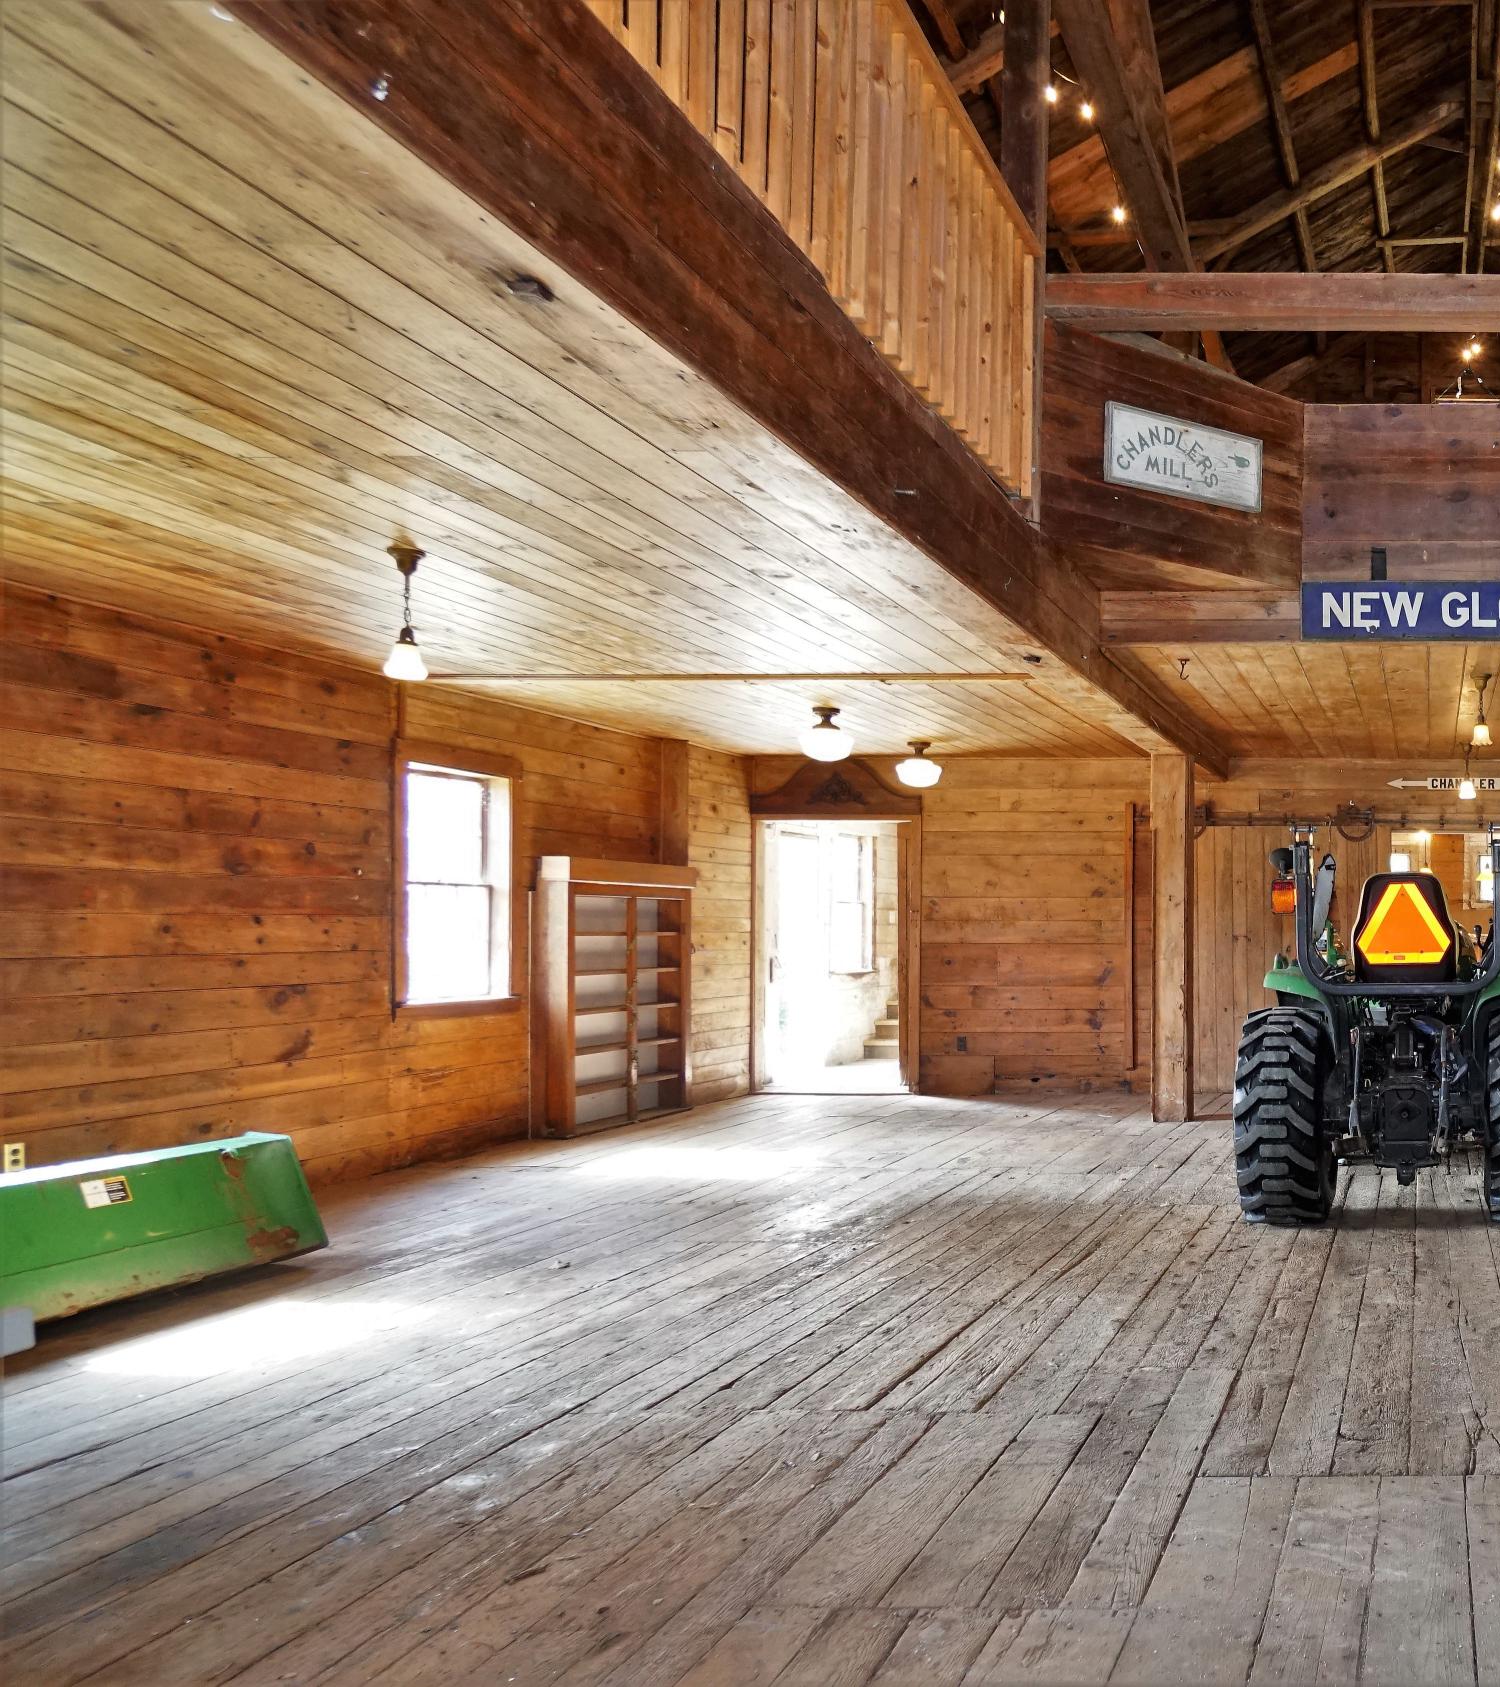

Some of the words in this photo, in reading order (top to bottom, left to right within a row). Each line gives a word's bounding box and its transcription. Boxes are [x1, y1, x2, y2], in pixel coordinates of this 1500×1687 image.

[1145, 454, 1193, 481] MILL
[1321, 591, 1424, 629] NEW
[1431, 778, 1495, 790] CHANLER
